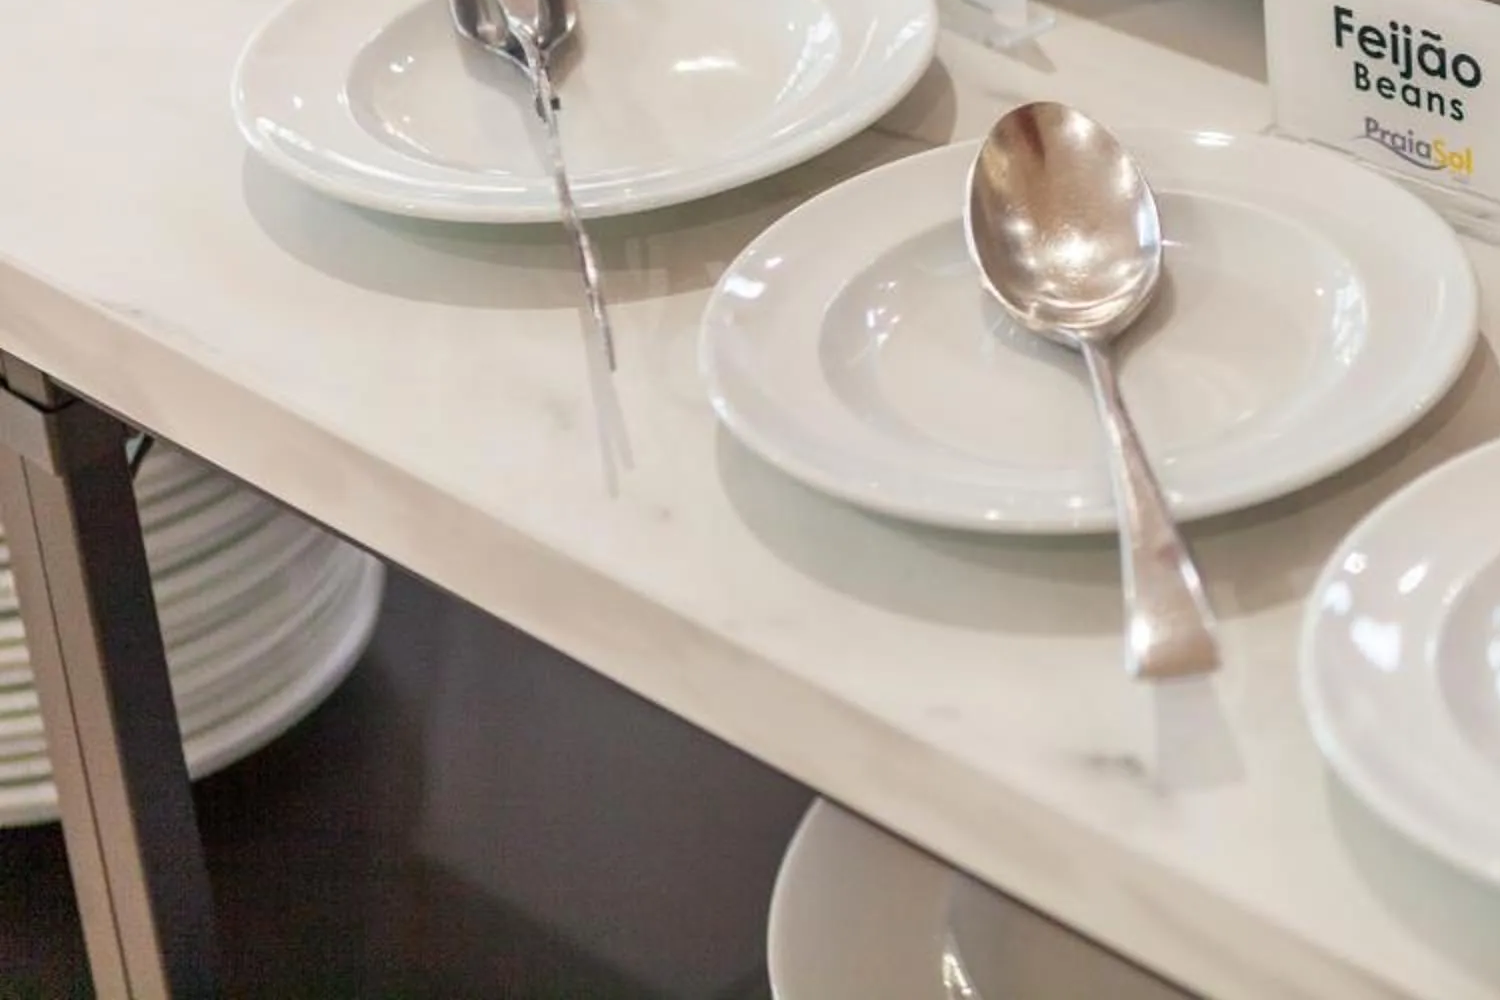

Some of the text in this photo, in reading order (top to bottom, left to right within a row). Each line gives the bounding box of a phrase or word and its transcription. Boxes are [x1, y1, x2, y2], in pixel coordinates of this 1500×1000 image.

[1333, 5, 1482, 89] Feijão
[1354, 61, 1465, 121] Beans
[1364, 116, 1474, 175] PraiaSol
